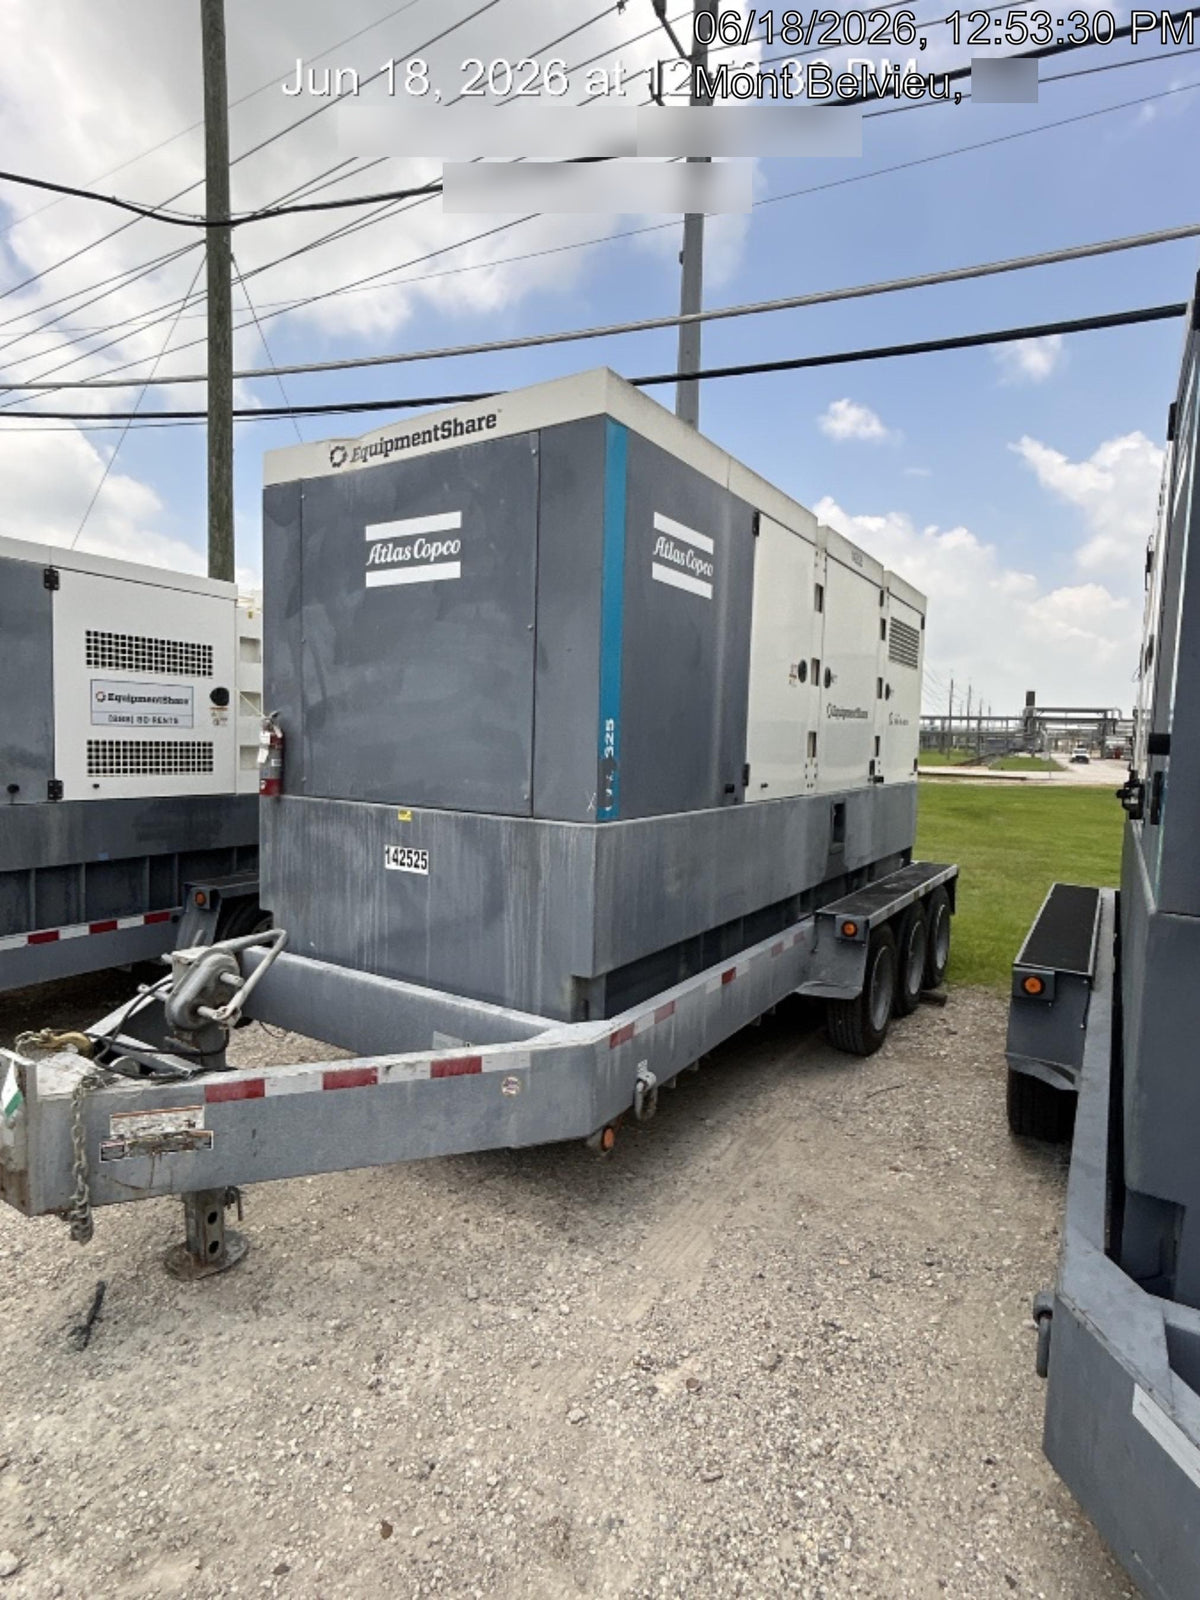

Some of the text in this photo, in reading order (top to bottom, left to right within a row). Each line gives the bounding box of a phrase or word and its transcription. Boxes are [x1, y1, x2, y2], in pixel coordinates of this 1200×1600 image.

[350, 412, 498, 463] EquipmentShare
[365, 537, 461, 566] Atlas Copco
[652, 536, 714, 577] Atlas Copco
[604, 718, 614, 758] 325
[385, 848, 427, 870] 142525
